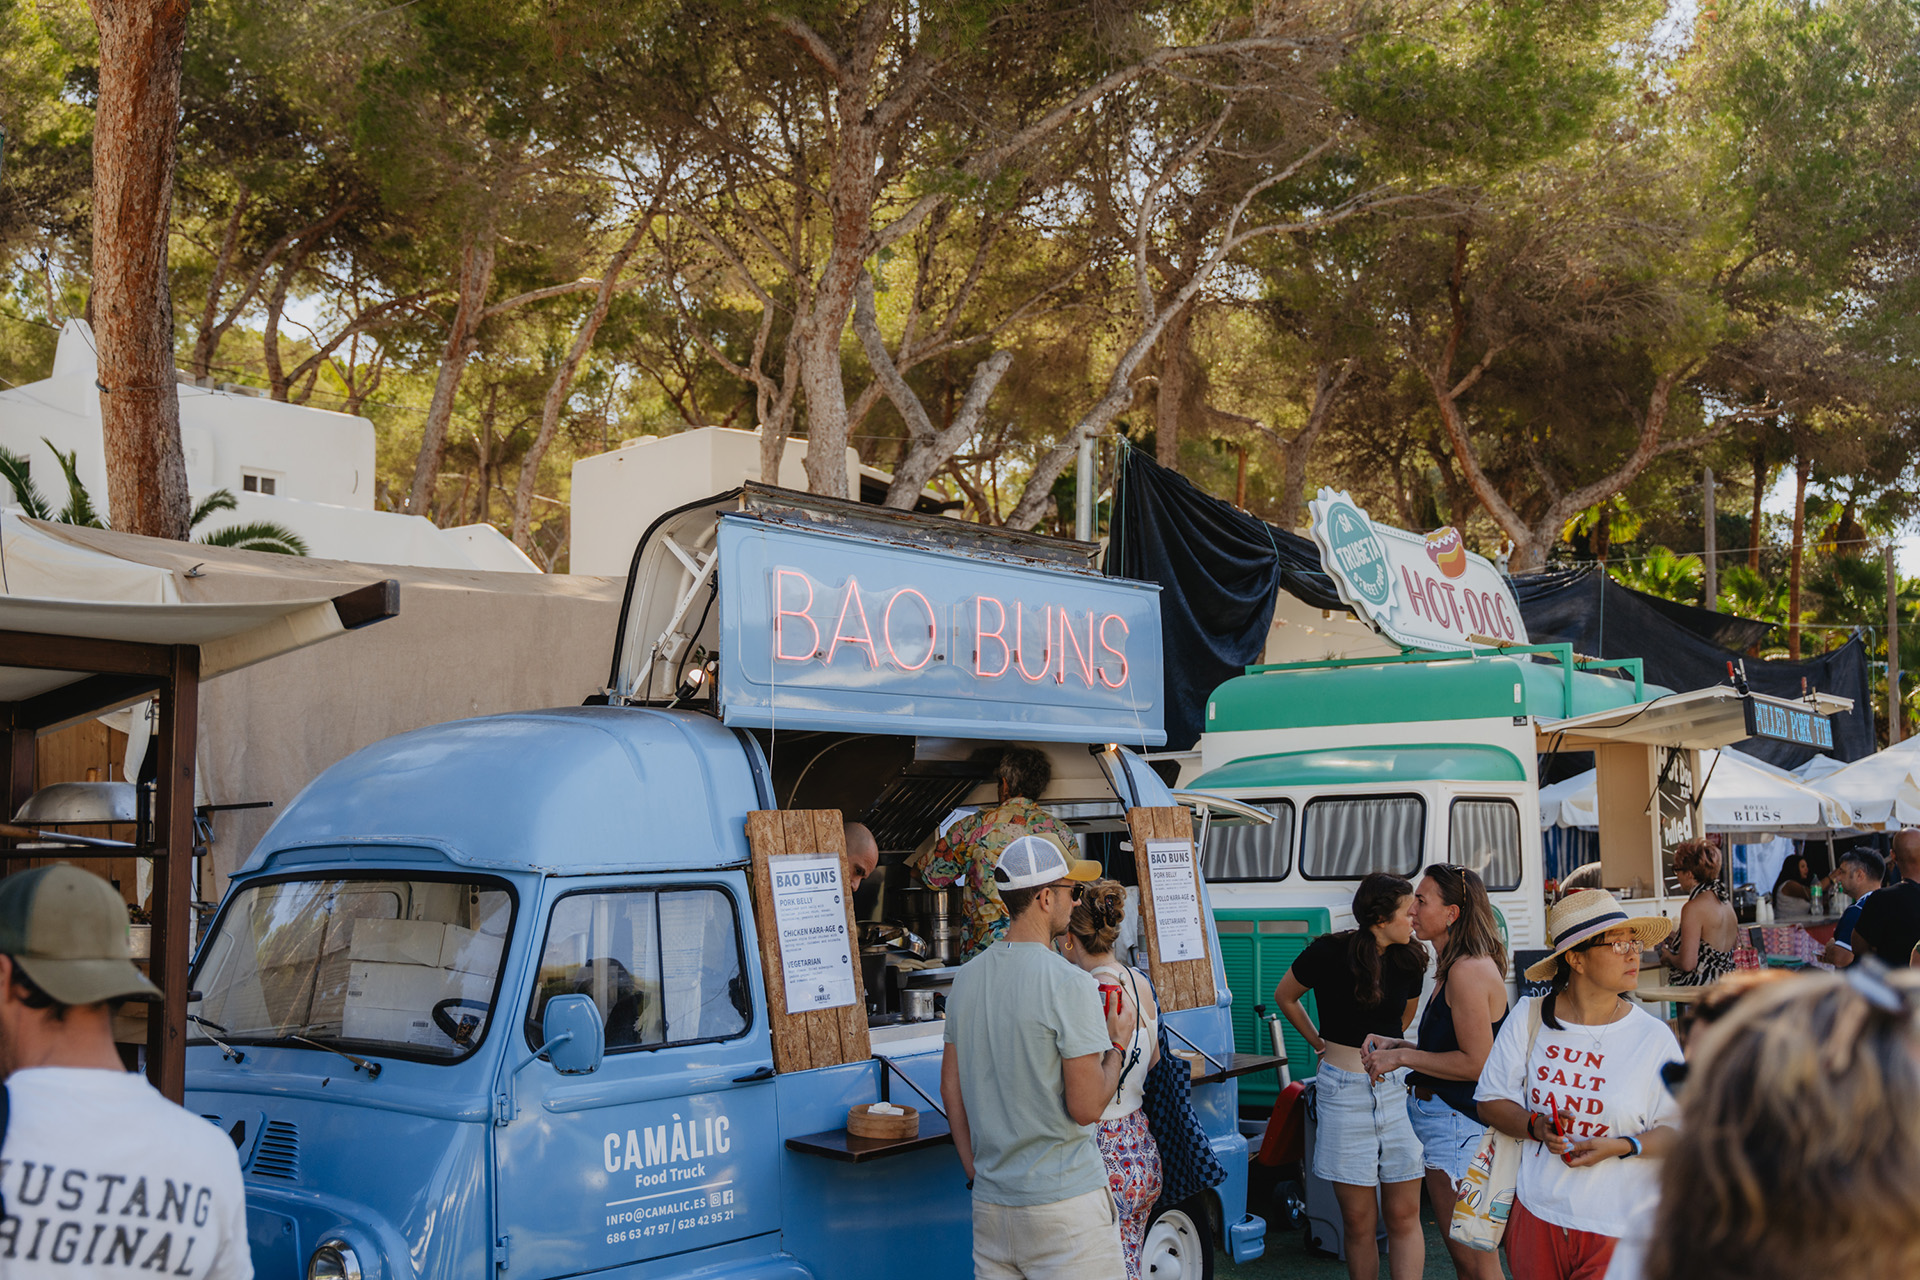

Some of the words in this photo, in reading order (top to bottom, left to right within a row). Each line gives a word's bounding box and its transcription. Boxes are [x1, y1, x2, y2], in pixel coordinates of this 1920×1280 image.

[1338, 513, 1353, 533] SA
[776, 569, 937, 671] BAO
[976, 596, 1129, 689] BUNS
[1754, 702, 1788, 738] PULLED
[1789, 711, 1813, 744] PORK
[1664, 803, 1693, 847] Pulled
[1734, 811, 1781, 821] BLISS
[1151, 853, 1167, 864] BAO
[1169, 852, 1190, 863] BUNS
[776, 873, 800, 888] BAO
[804, 870, 837, 885] BUNS
[779, 899, 796, 907] PORK
[796, 897, 813, 905] BELLY
[783, 928, 809, 938] CHICKEN
[809, 925, 836, 935] KARA-AGE
[787, 957, 822, 969] VEGETARIAN
[1545, 1044, 1605, 1070] SUN
[1537, 1065, 1606, 1092] SALT
[1531, 1087, 1604, 1115] SAND
[603, 1113, 731, 1173] CAMÀLIC
[635, 1169, 667, 1188] Food
[669, 1163, 706, 1181] Truck
[0, 1158, 212, 1228] USTANG
[606, 1198, 706, 1226] INFO@CAMALIC.ES
[606, 1231, 627, 1244] 686
[628, 1228, 642, 1240] 63
[643, 1226, 656, 1237] 47
[657, 1223, 670, 1234] 97
[671, 1219, 676, 1234] /
[678, 1217, 696, 1230] 628
[697, 1214, 710, 1226] 42
[711, 1212, 723, 1223] 95
[724, 1210, 734, 1220] 21
